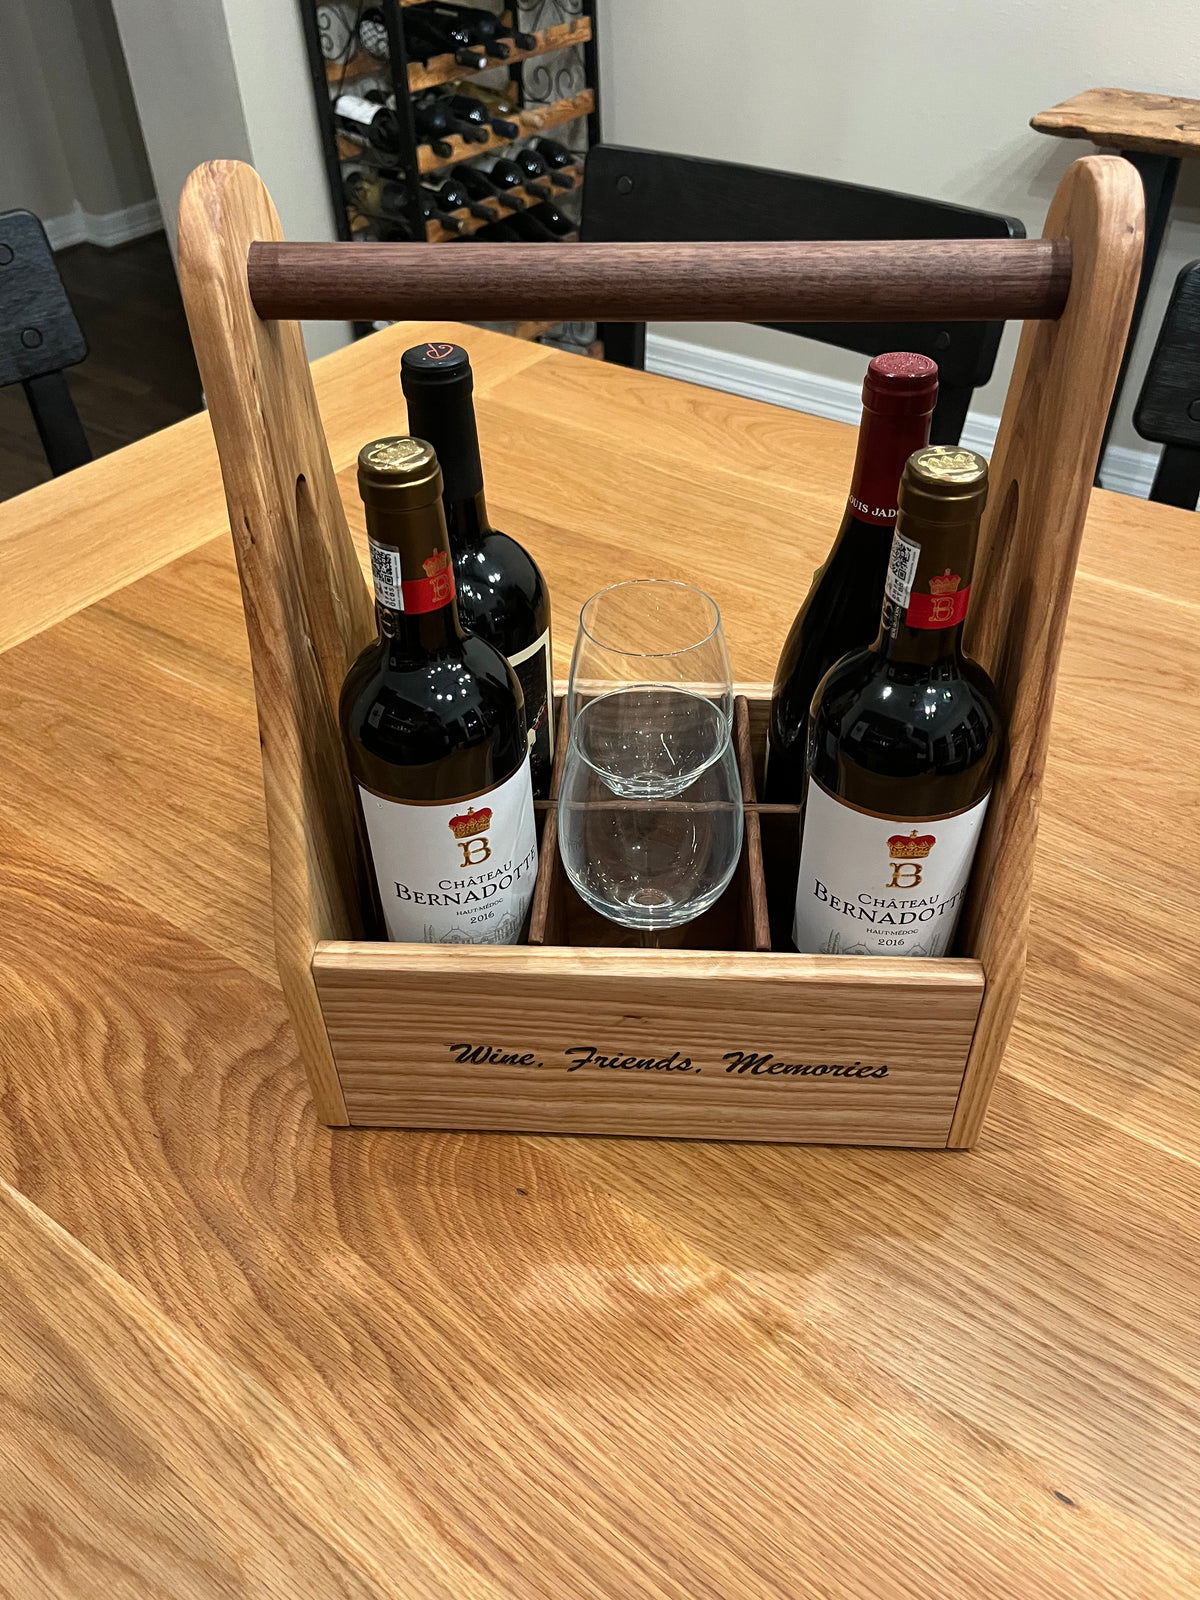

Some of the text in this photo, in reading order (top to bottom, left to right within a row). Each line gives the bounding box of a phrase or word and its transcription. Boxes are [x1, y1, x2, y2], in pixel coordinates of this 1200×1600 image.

[928, 596, 954, 622] B
[457, 837, 492, 868] B
[393, 844, 536, 907] BERNADOTTE
[438, 860, 513, 890] CHÂTEAU
[885, 862, 923, 889] B
[857, 893, 940, 910] CHÂTEAU
[470, 910, 495, 925] 2016
[877, 938, 905, 947] 2016
[722, 1051, 889, 1079] Memories
